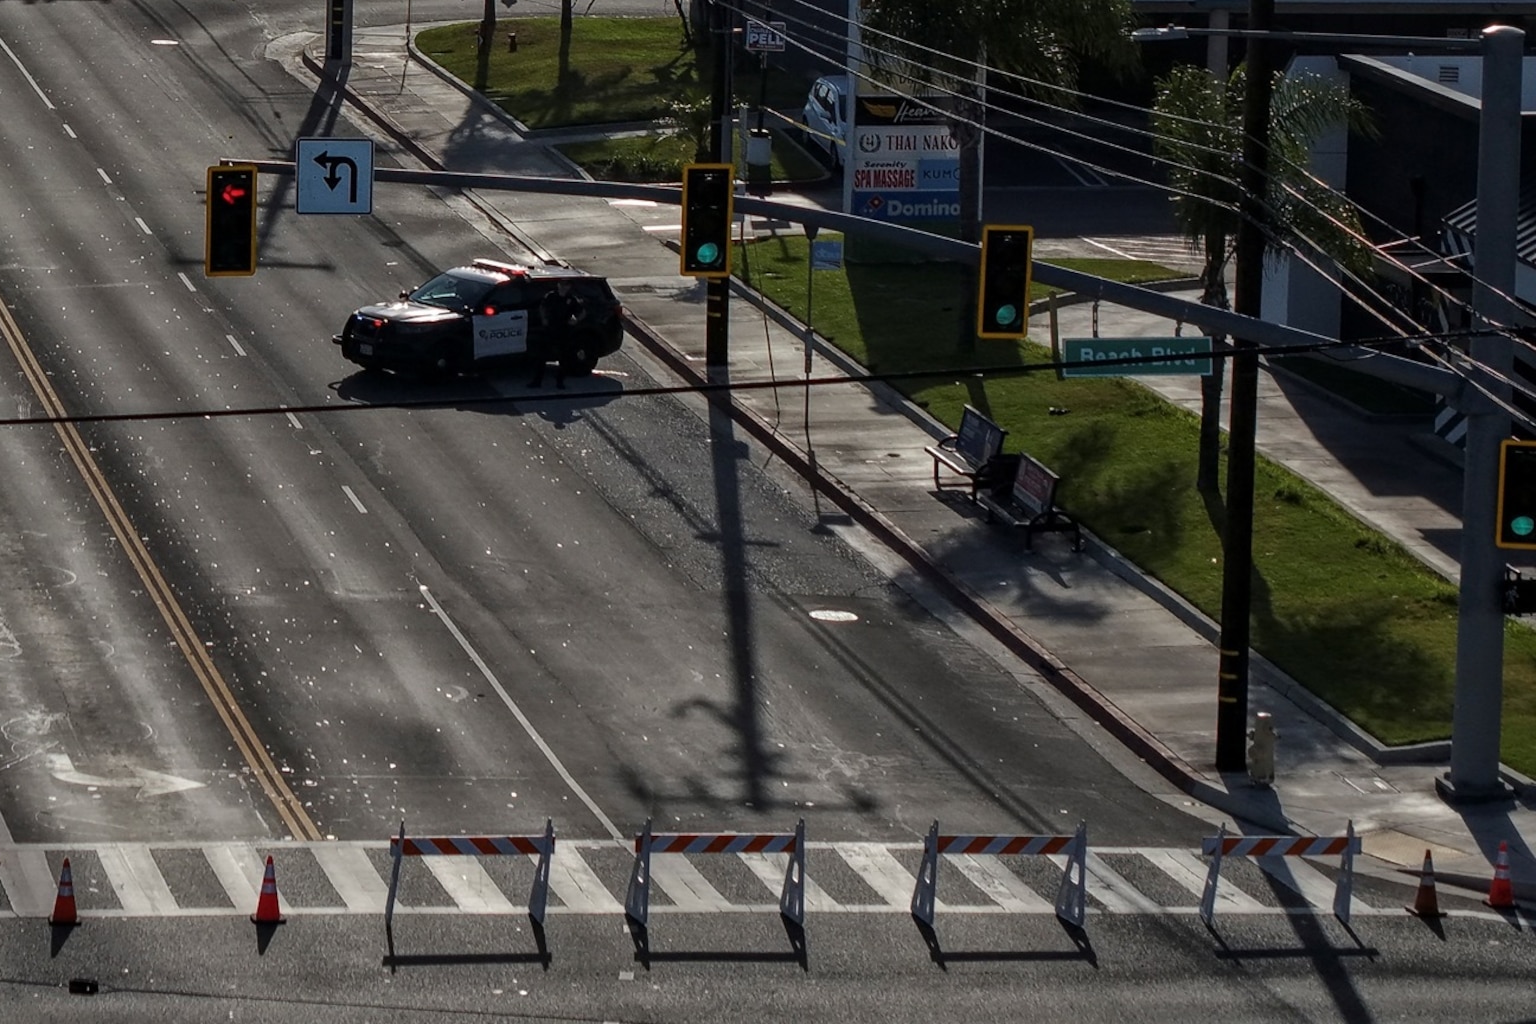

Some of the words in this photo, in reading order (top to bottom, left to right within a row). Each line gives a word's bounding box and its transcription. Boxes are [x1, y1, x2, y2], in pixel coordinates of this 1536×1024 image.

[750, 32, 783, 45] PELL
[885, 135, 917, 151] THAI
[922, 134, 960, 151] NAKO
[864, 160, 907, 168] Serenity
[854, 169, 872, 188] SPA
[873, 169, 915, 188] MASSAGE
[923, 167, 960, 181] KUMO
[887, 198, 961, 217] Domino
[489, 328, 522, 339] POLICE
[1080, 347, 1143, 367] Beach
[1151, 346, 1196, 367] Blvd
